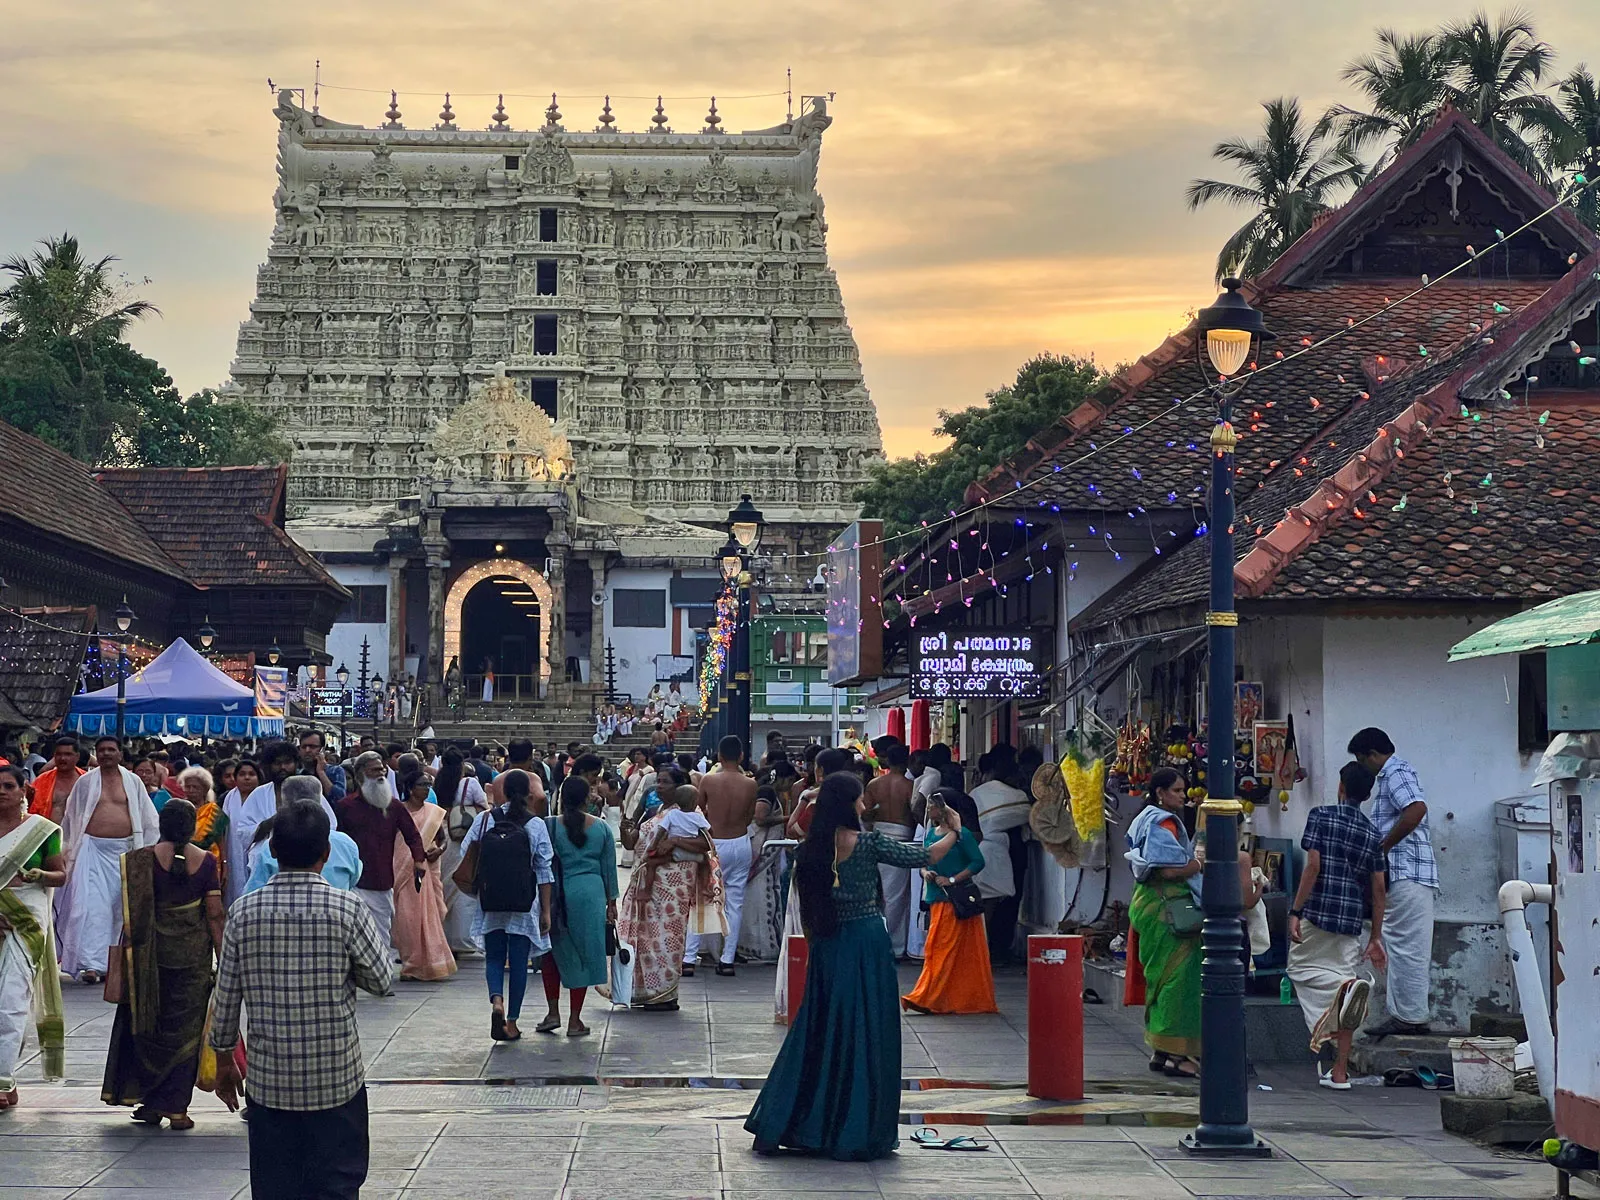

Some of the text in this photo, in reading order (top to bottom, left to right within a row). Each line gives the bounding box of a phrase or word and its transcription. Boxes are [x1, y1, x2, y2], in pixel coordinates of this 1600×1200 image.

[920, 632, 947, 654] ശ്രീ
[920, 653, 1034, 676] സ്വാമി ക്ഷേത്രം
